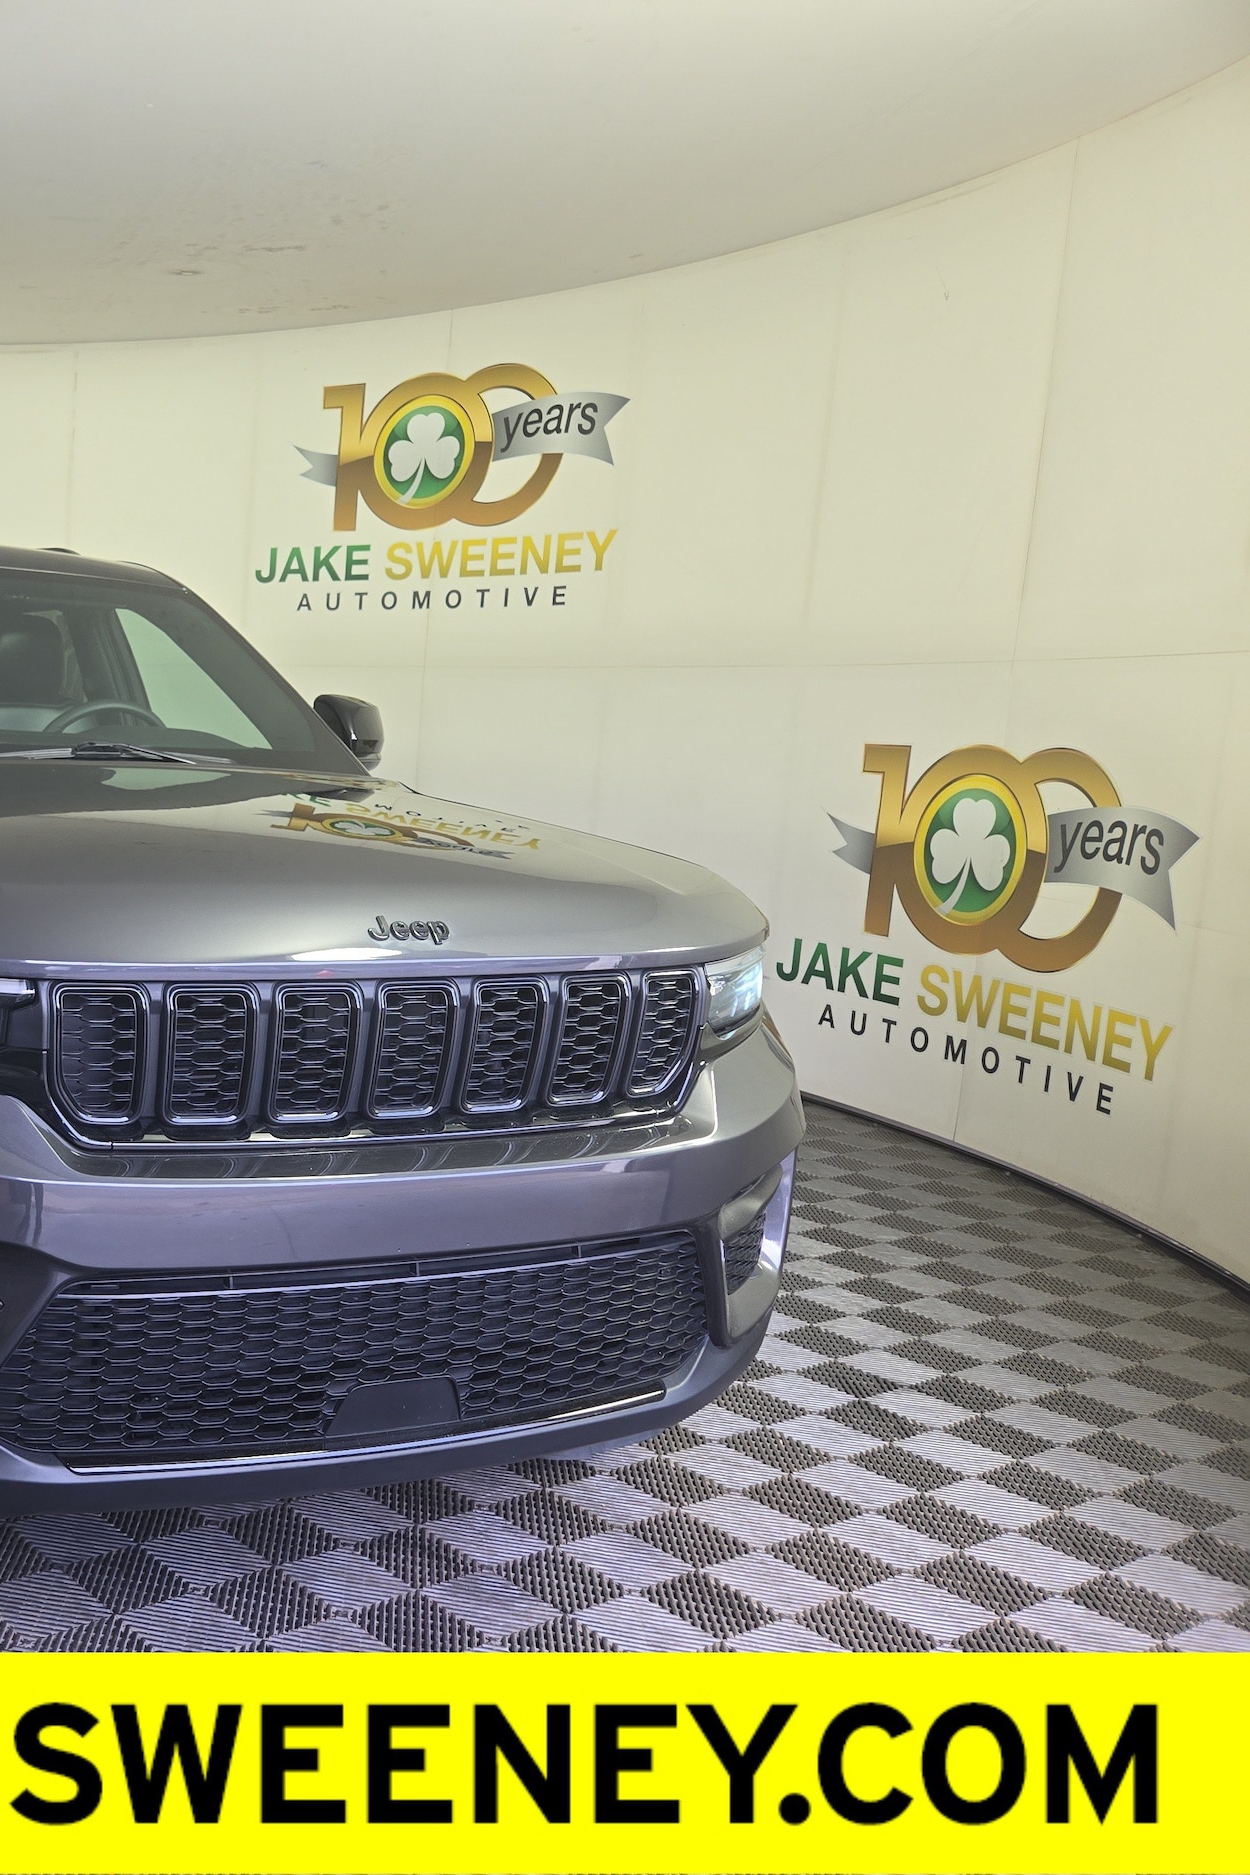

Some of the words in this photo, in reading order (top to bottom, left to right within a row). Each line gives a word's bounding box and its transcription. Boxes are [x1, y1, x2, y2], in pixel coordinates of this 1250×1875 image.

[323, 363, 564, 532] 100
[499, 399, 599, 453] years
[255, 544, 371, 583] JAKE
[384, 529, 618, 581] SWEENEY
[296, 585, 568, 611] AUTOMOTIVE
[862, 743, 1123, 973] 100
[1053, 819, 1165, 876] years
[367, 915, 450, 945] Jeep
[776, 938, 904, 1006] JAKE
[917, 964, 1173, 1082] SWEENEY
[818, 1004, 1114, 1115] AUTOMOTIVE
